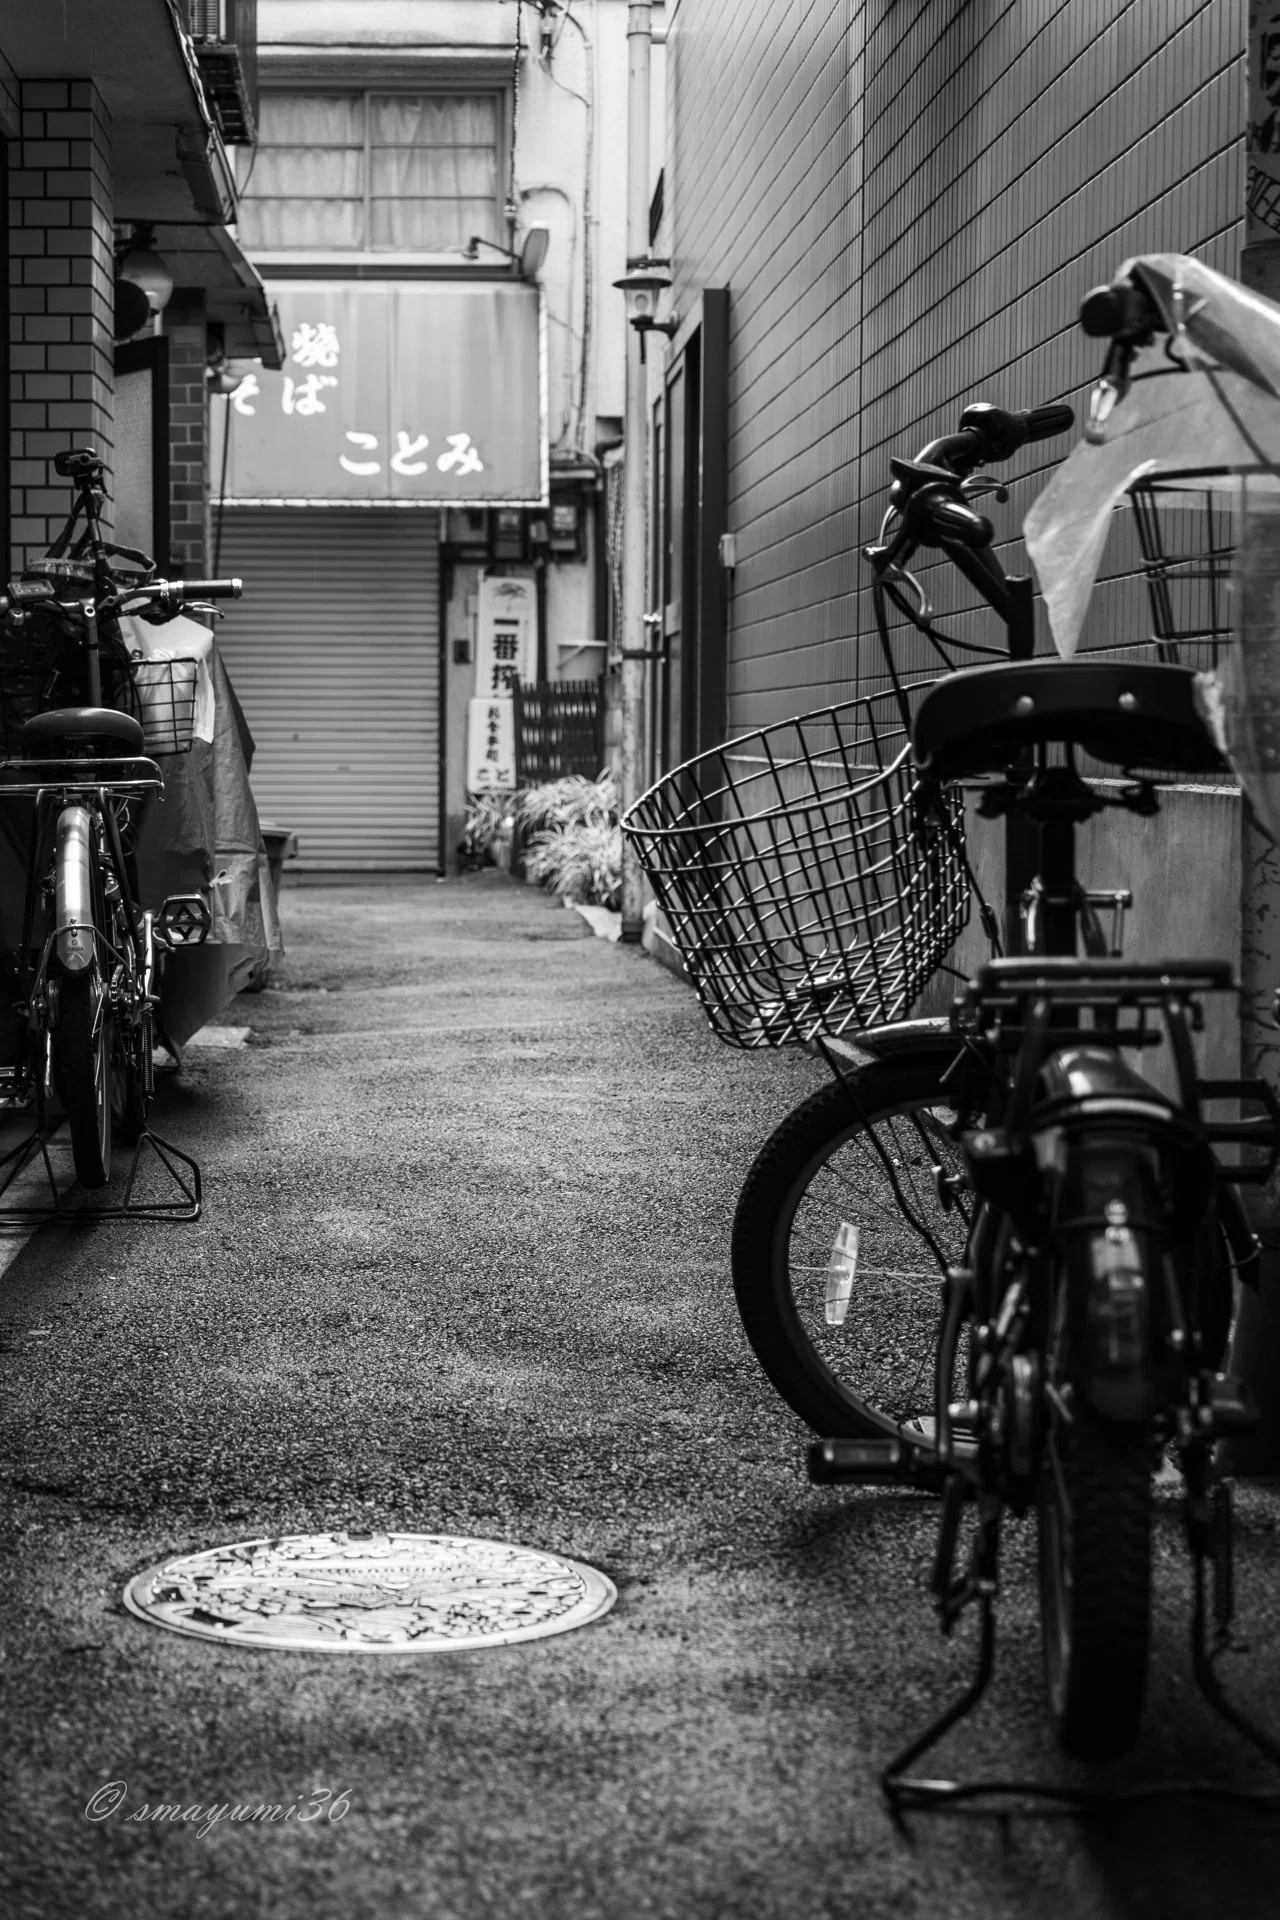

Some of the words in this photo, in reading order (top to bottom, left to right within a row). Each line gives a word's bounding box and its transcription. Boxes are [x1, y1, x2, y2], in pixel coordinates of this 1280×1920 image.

[338, 430, 485, 477] ことみ
[491, 618, 519, 698] 一番搾
